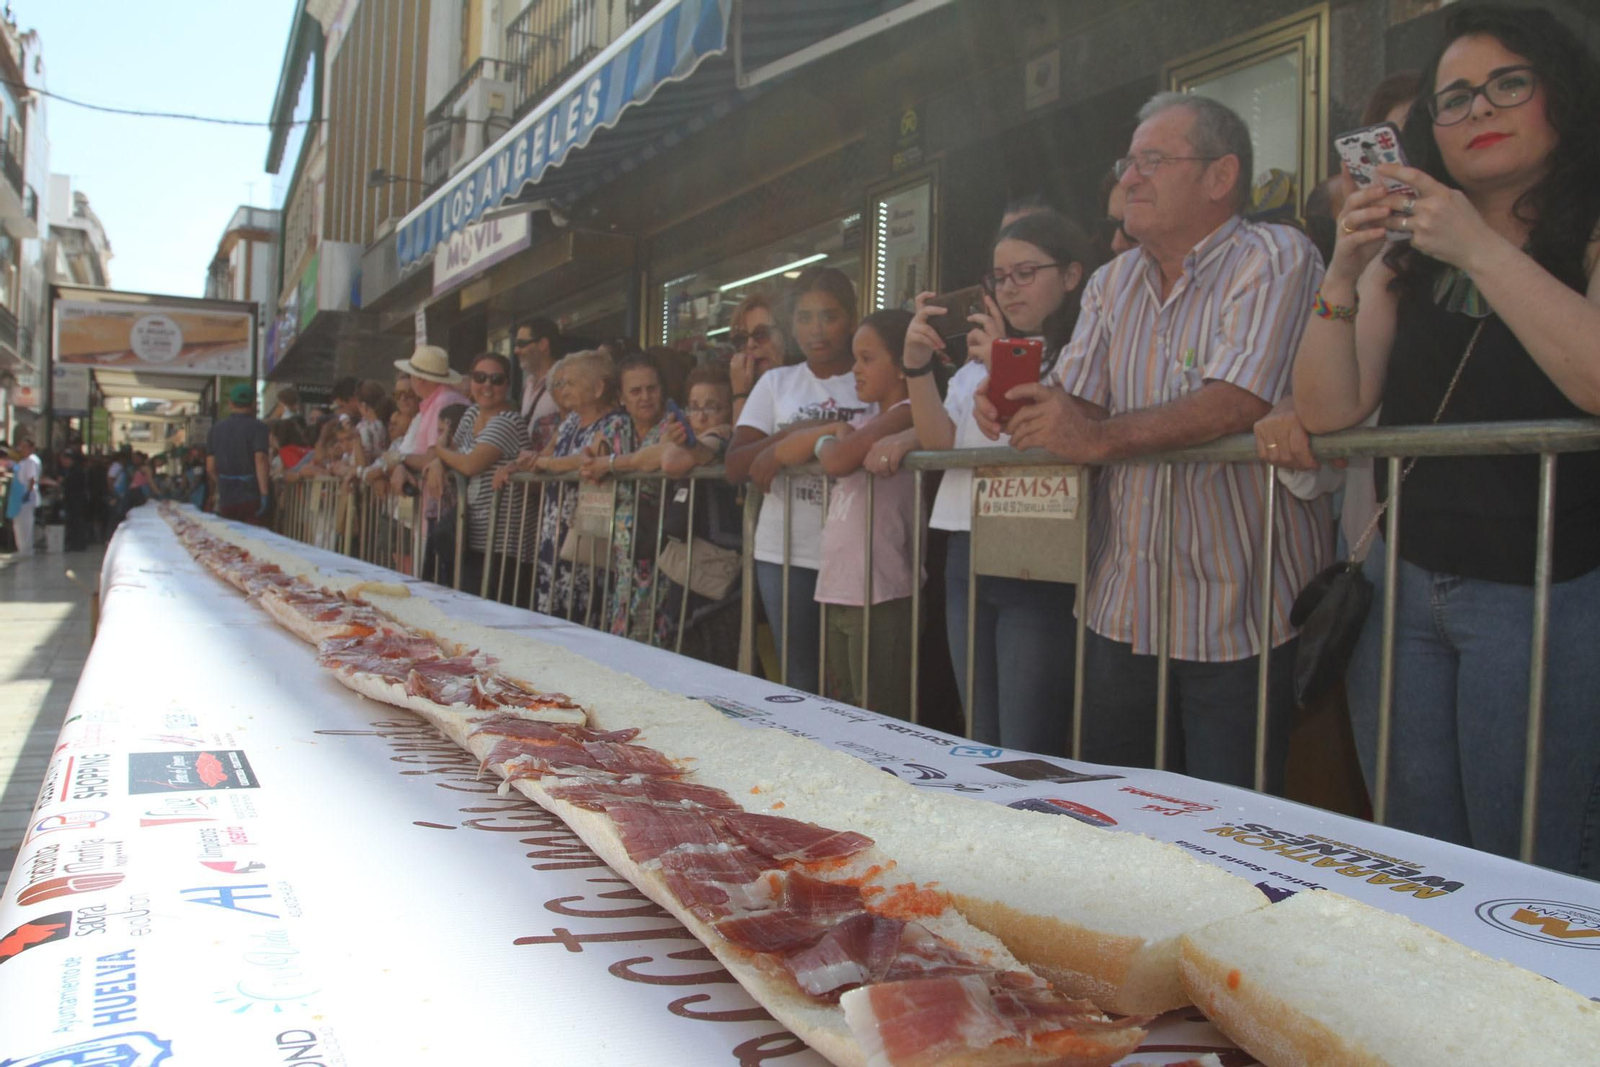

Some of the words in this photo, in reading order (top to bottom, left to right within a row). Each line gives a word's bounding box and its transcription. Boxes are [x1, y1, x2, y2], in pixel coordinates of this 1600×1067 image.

[441, 179, 475, 231] LOS
[481, 78, 602, 203] ANGELES
[988, 473, 1070, 498] REMSA
[72, 753, 110, 799] SHOPPING
[17, 844, 60, 897] hacienda
[1175, 839, 1218, 856] Otilia
[1203, 826, 1449, 899] MARATHON
[1217, 852, 1268, 873] Santa
[1243, 822, 1465, 893] WELLNESS
[53, 970, 82, 1034] Ayuntamiento
[92, 949, 138, 1027] HUELVA
